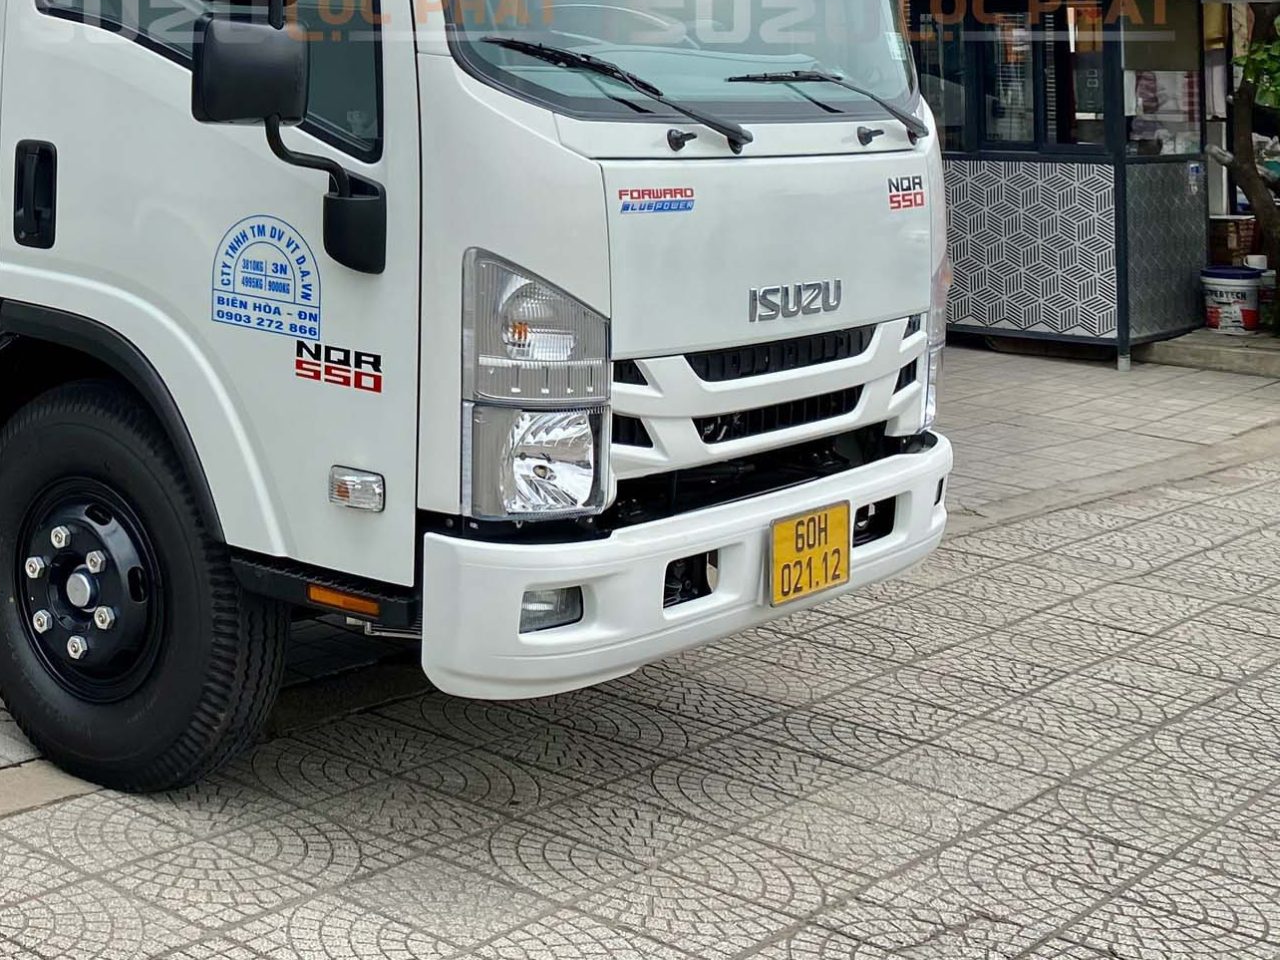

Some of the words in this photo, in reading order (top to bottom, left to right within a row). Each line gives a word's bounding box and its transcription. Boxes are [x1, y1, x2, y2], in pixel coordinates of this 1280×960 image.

[619, 187, 694, 200] FORWARD
[888, 175, 923, 193] NQR
[889, 191, 925, 210] 550
[225, 229, 249, 260] TNHH
[249, 224, 266, 239] TM
[269, 225, 285, 242] DV
[285, 236, 301, 254] VT
[220, 261, 232, 286] CTY
[271, 262, 288, 276] 3N
[217, 295, 248, 310] BIÊN
[253, 301, 282, 317] HÒA
[297, 310, 318, 323] ĐN
[749, 279, 842, 323] ISUZU
[216, 309, 251, 325] 0903
[256, 317, 283, 331] 272
[289, 323, 318, 337] 866
[296, 339, 383, 374] NQR
[295, 358, 382, 393] 550
[795, 512, 829, 553] 60H
[781, 547, 841, 597] 021.12
